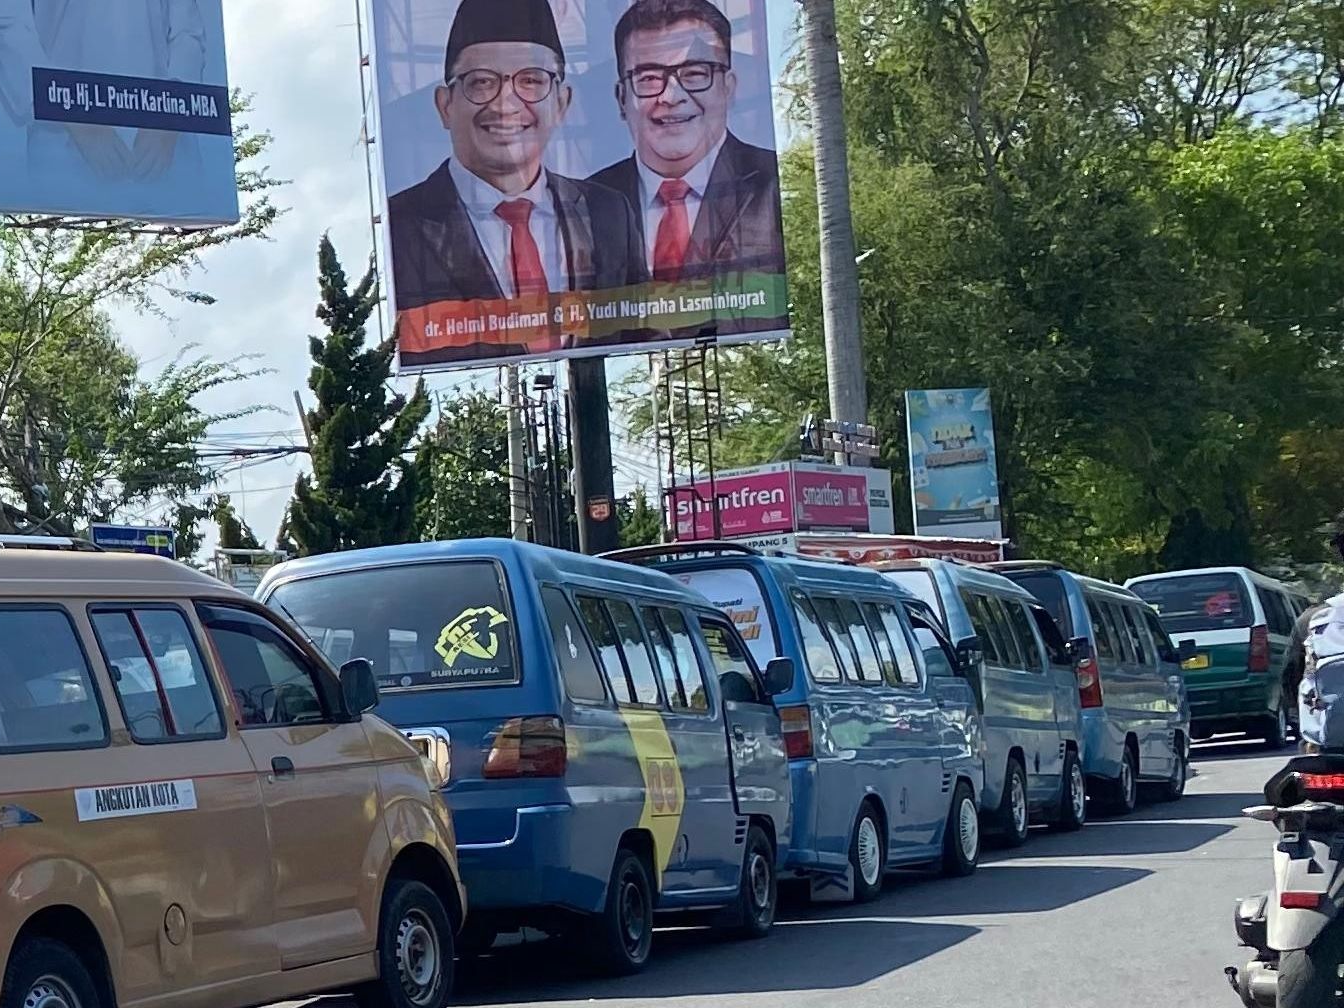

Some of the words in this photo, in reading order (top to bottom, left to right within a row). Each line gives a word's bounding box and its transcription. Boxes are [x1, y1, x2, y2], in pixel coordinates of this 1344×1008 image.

[48, 80, 74, 109] drg.
[76, 83, 93, 110] Hj.
[108, 86, 139, 111] Putri
[191, 94, 218, 117] MBA
[425, 321, 442, 338] dr.
[446, 315, 485, 334] Helmi
[488, 310, 548, 331] Budiman
[554, 309, 564, 323] &
[570, 305, 584, 322] H.
[587, 301, 617, 320] Yudi
[620, 297, 677, 320] Nugraha
[679, 289, 766, 315] Lasminingrat
[95, 786, 150, 813] ANGKUTAN
[151, 781, 179, 807] KOTA
